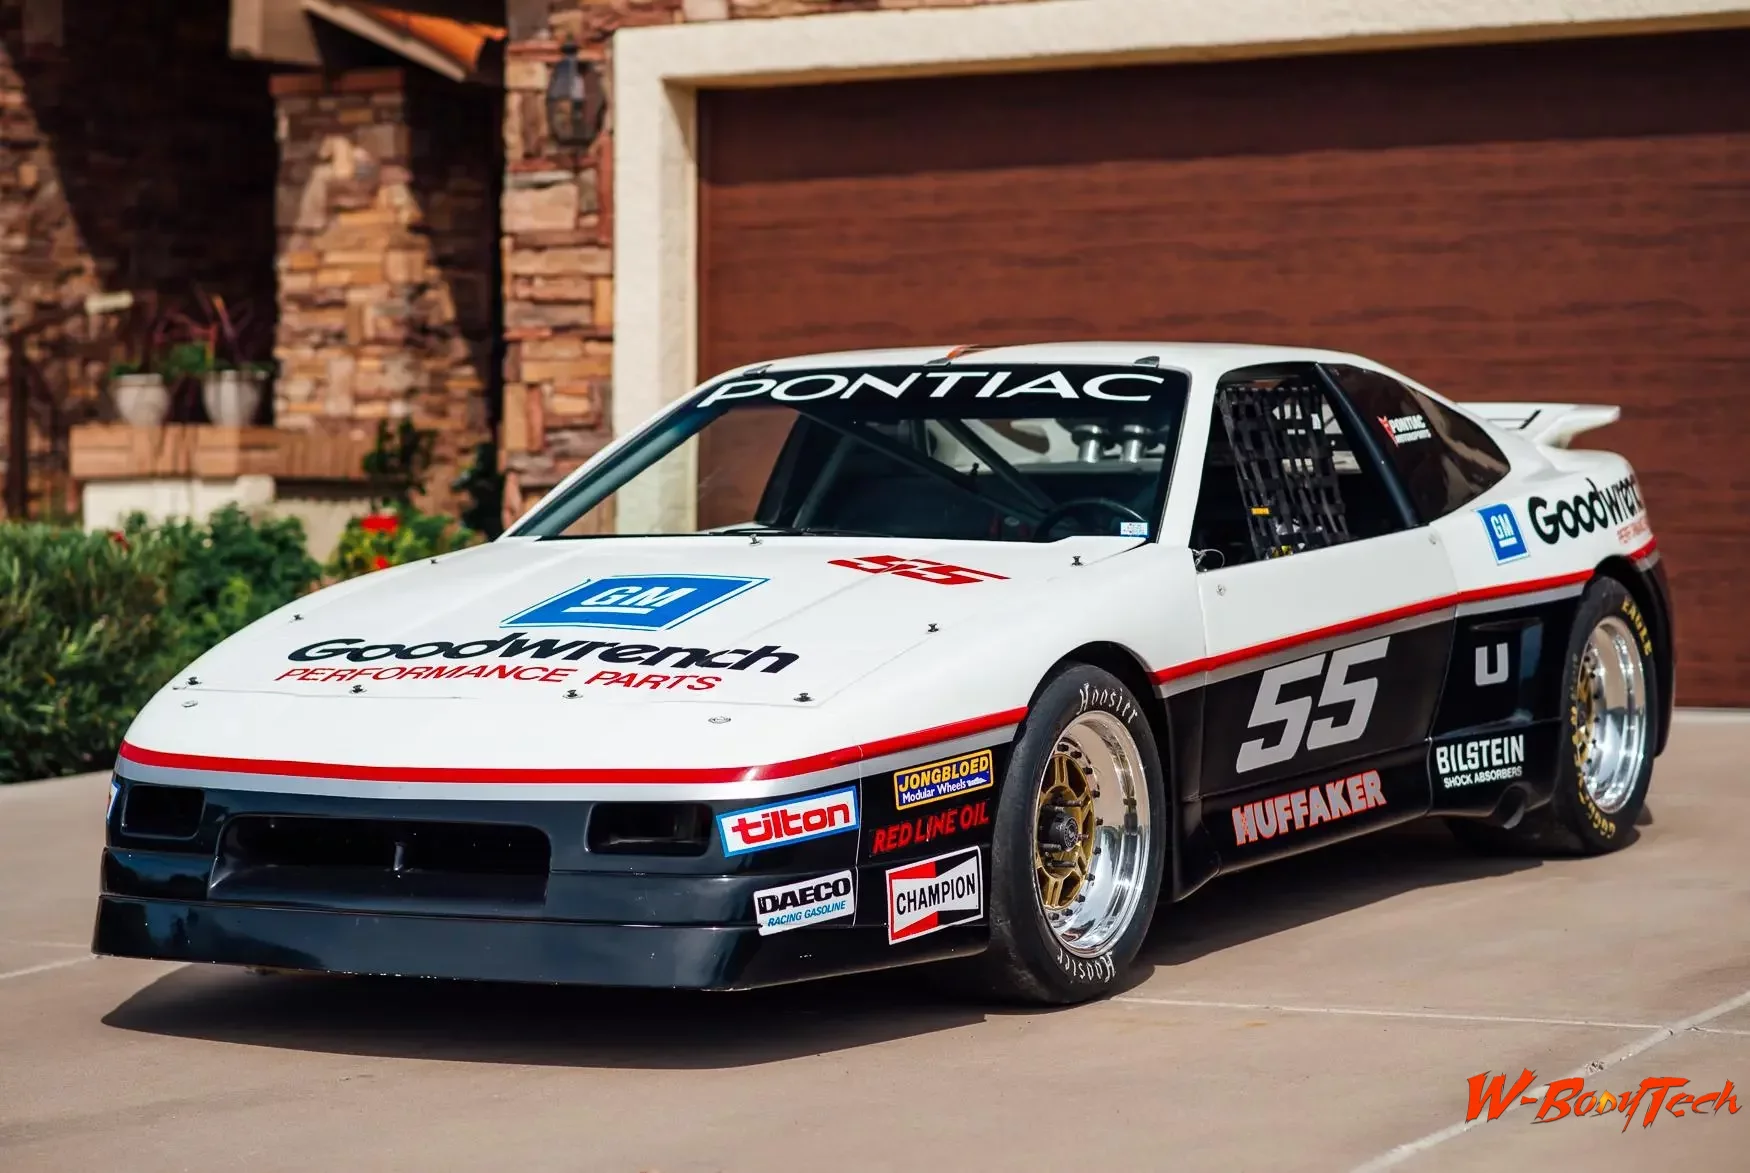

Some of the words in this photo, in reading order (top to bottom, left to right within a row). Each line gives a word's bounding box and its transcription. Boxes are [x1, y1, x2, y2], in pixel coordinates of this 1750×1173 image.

[697, 371, 1164, 408] PONTIAC
[1490, 513, 1515, 539] GM
[827, 554, 1011, 585] 55
[581, 586, 697, 607] GM
[288, 632, 800, 674] Goodwrench
[1475, 642, 1509, 687] U
[274, 665, 578, 683] PERFORMANCE
[584, 670, 723, 691] PARTS
[1076, 682, 1138, 724] Hoosier
[1236, 636, 1391, 774] 55
[1436, 734, 1524, 775] BILSTEIN
[899, 756, 989, 792] JONGBLOED
[902, 788, 935, 804] Modular
[937, 779, 966, 795] Wheels
[1443, 773, 1473, 789] SHOCK
[1474, 765, 1522, 784] ABSORBERS
[731, 802, 850, 845] tilton
[1231, 769, 1387, 846] HUFFAKER
[873, 821, 912, 855] RED
[914, 808, 958, 843] LINE
[960, 801, 989, 830] OIL
[757, 878, 851, 914] DAECO
[896, 873, 976, 915] CHAMPION
[768, 911, 802, 927] RACING
[804, 900, 846, 919] GASOLINE
